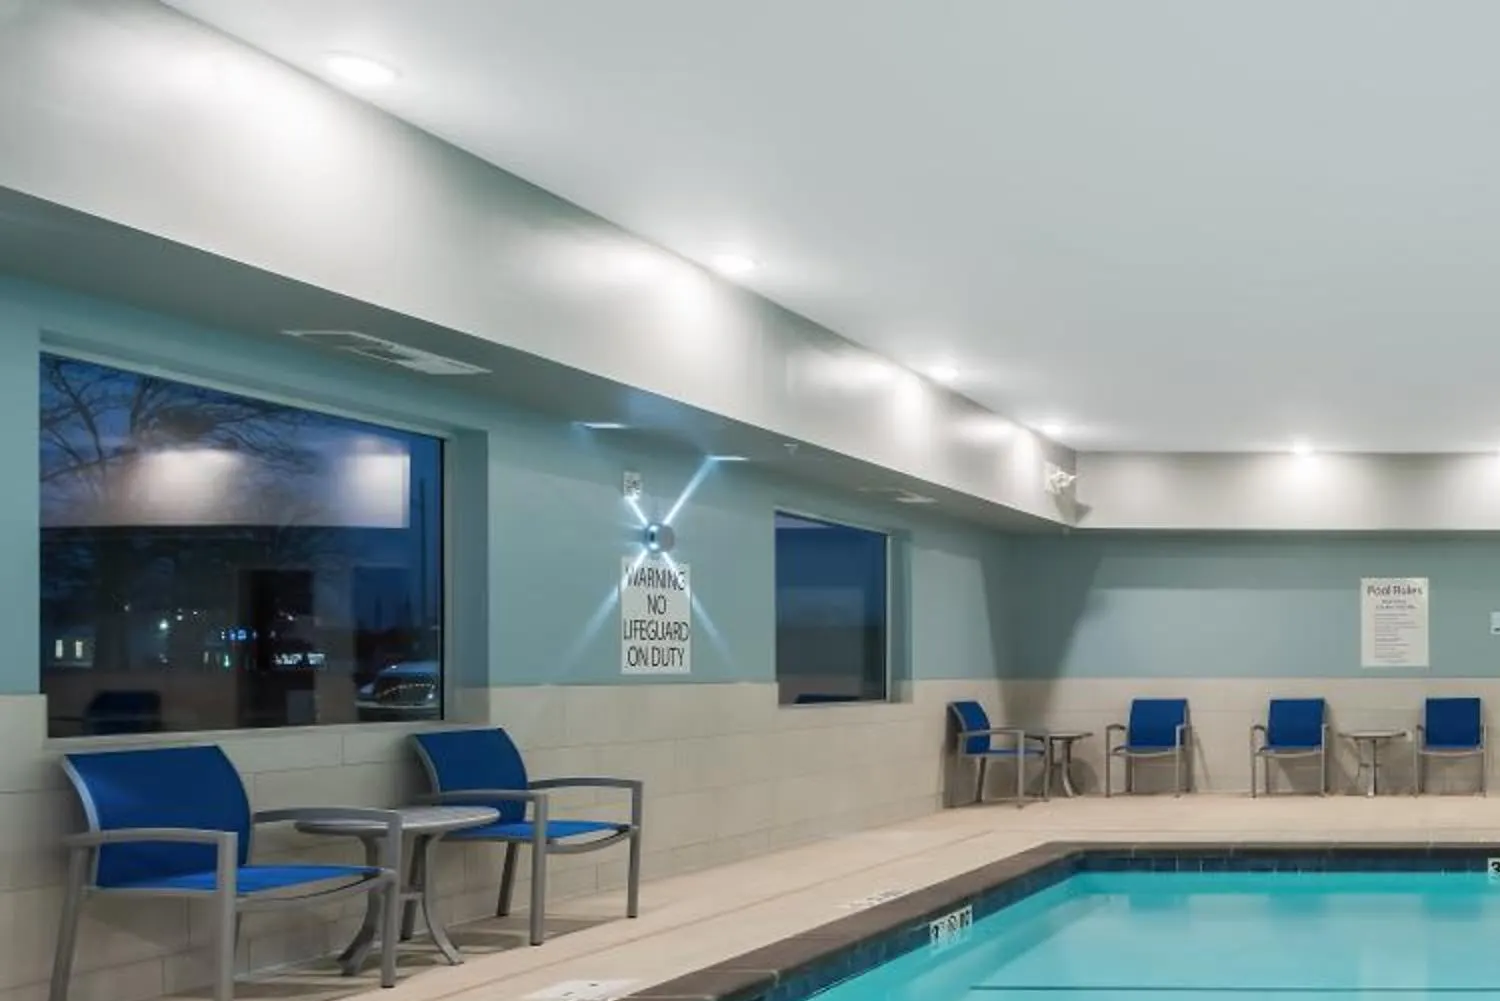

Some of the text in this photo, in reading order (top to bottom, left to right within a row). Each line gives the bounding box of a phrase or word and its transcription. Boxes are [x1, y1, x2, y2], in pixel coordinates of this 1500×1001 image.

[625, 567, 685, 590] WARNING
[647, 595, 667, 615] NO
[624, 619, 689, 641] LIFEGUARD
[627, 647, 685, 667] ON DUTY
